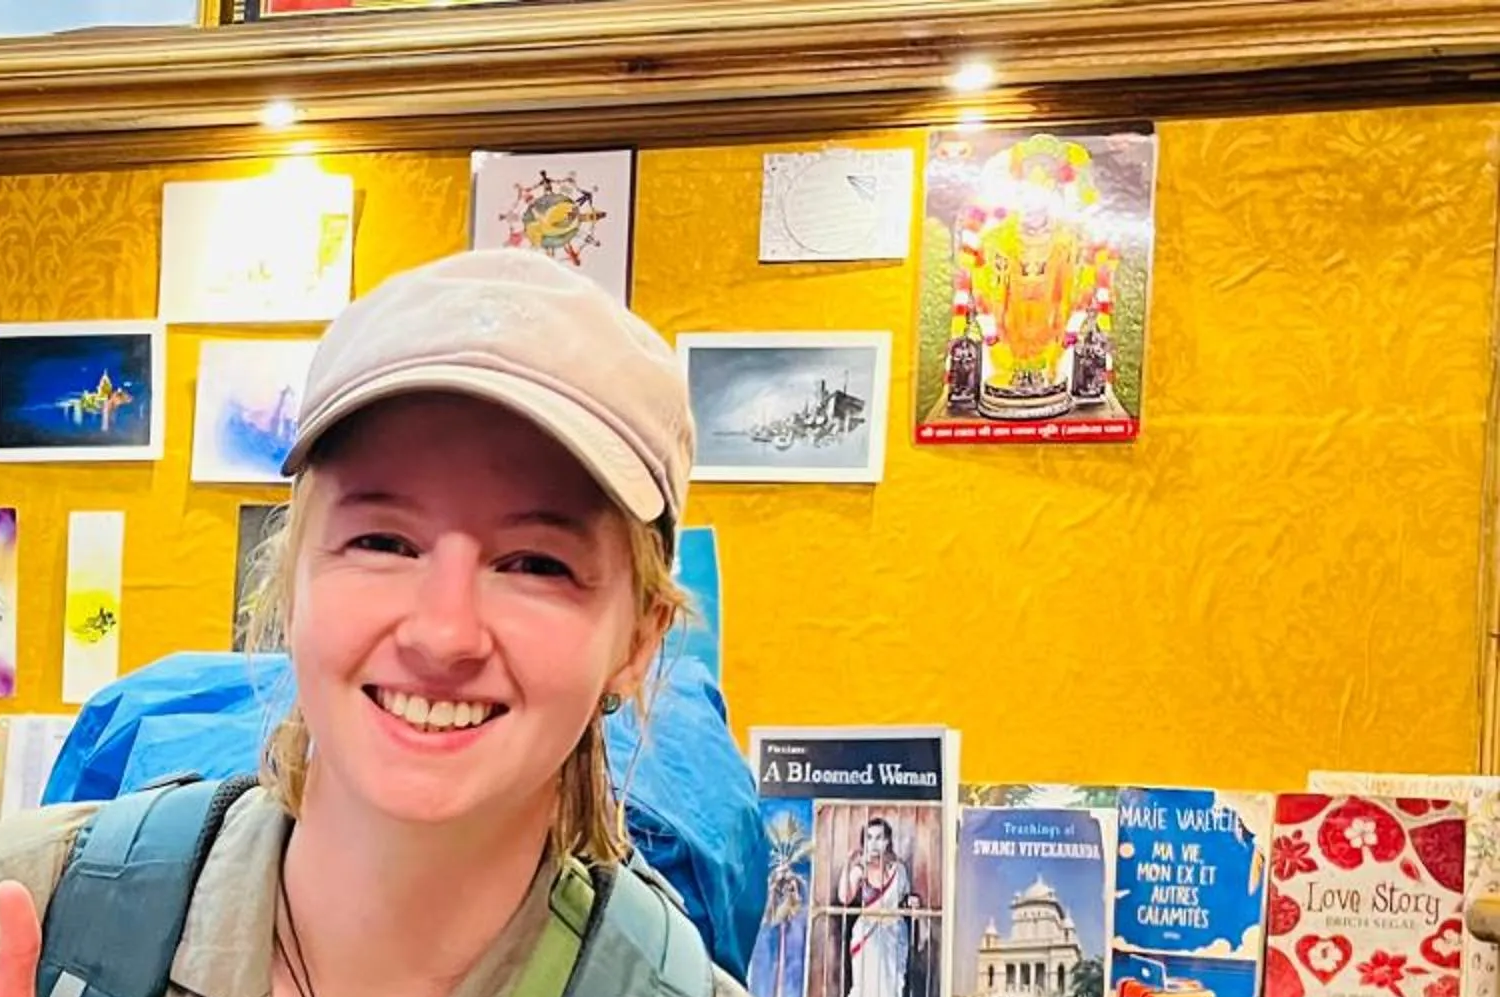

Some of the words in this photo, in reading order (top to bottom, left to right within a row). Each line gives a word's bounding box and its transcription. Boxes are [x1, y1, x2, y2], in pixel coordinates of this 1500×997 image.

[762, 761, 781, 783] A
[787, 761, 874, 785] Bloomed
[878, 763, 938, 787] Woman
[973, 840, 1016, 857] SWAMI
[1019, 841, 1101, 861] VIVEKANANDA
[1151, 840, 1175, 862] MA
[1137, 863, 1172, 883] MON
[1177, 865, 1195, 885] EX
[1200, 866, 1217, 886] ET
[1151, 885, 1200, 906] AUTRES
[1306, 881, 1360, 913] Love
[1372, 882, 1440, 925] Story
